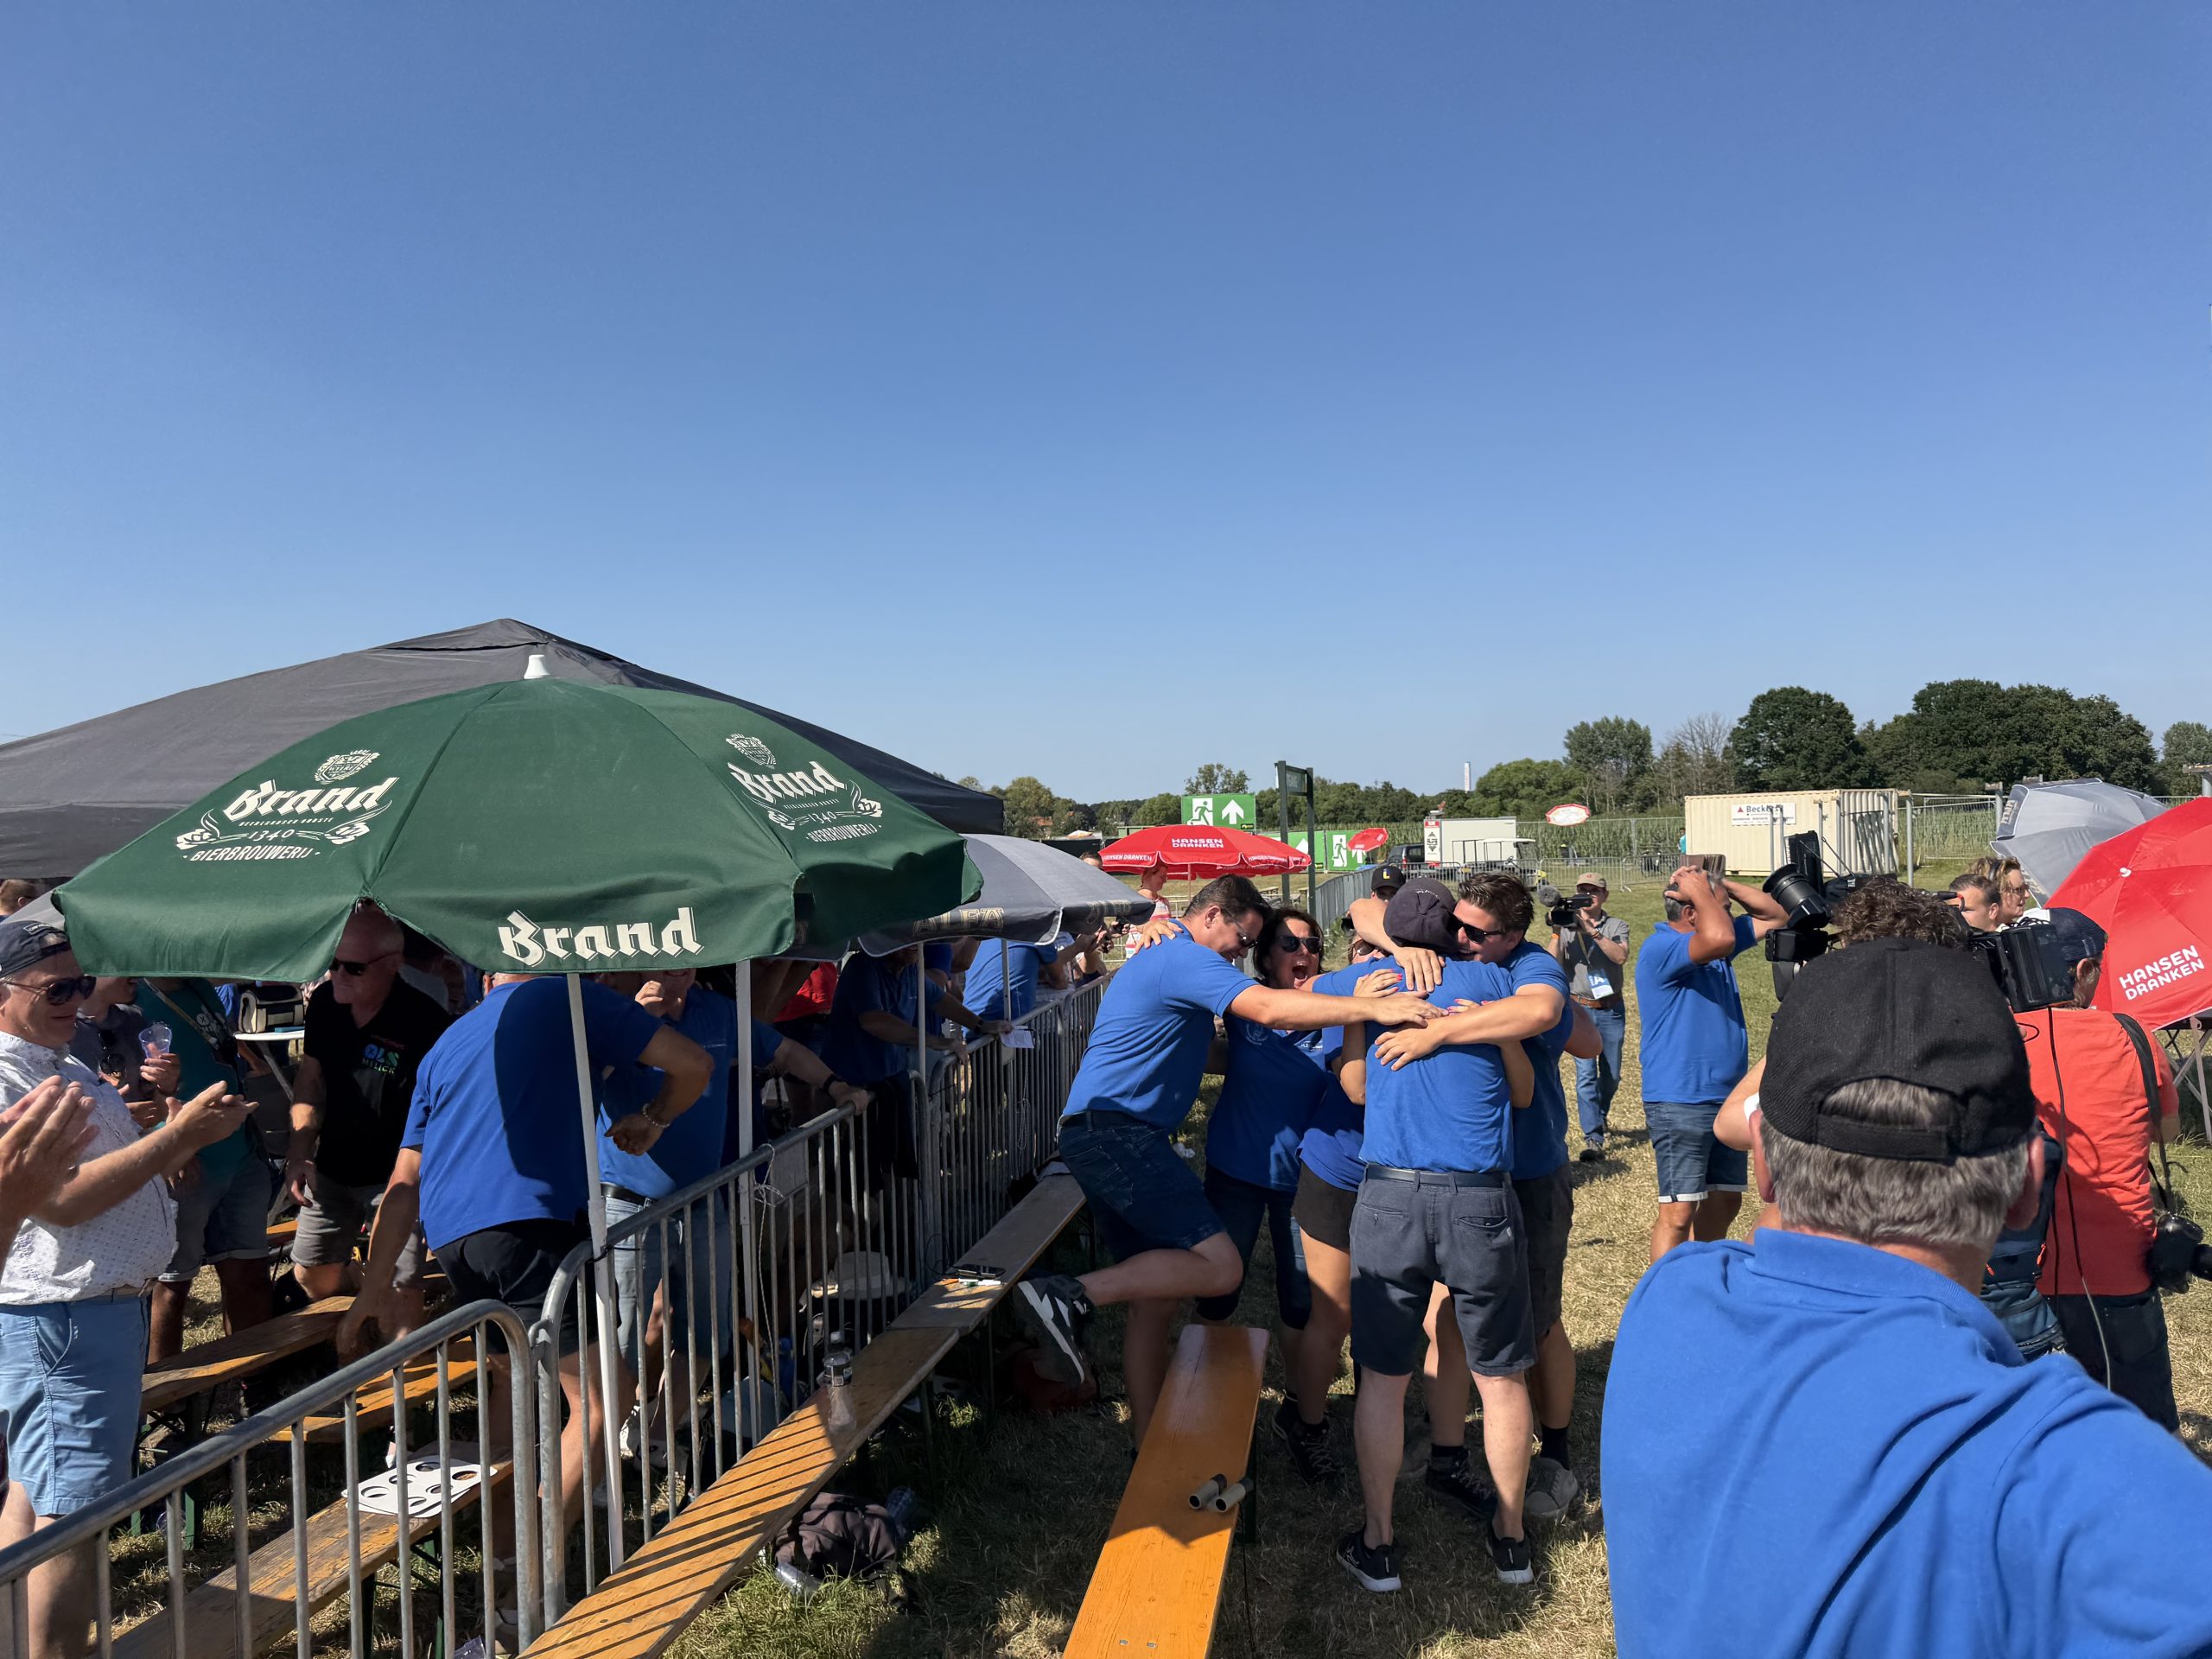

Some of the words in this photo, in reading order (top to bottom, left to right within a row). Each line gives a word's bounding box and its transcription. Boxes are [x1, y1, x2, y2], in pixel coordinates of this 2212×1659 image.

[223, 777, 400, 822] Brand
[728, 761, 847, 804] Brand
[248, 829, 295, 842] 1340
[808, 811, 836, 824] 1340
[808, 823, 878, 842] BIERBROUWERIJ
[189, 845, 314, 861] BIERBROUWERIJ
[498, 906, 705, 967] Brand
[2119, 944, 2199, 989] HANSEN
[2125, 958, 2205, 1001] DRANKEN
